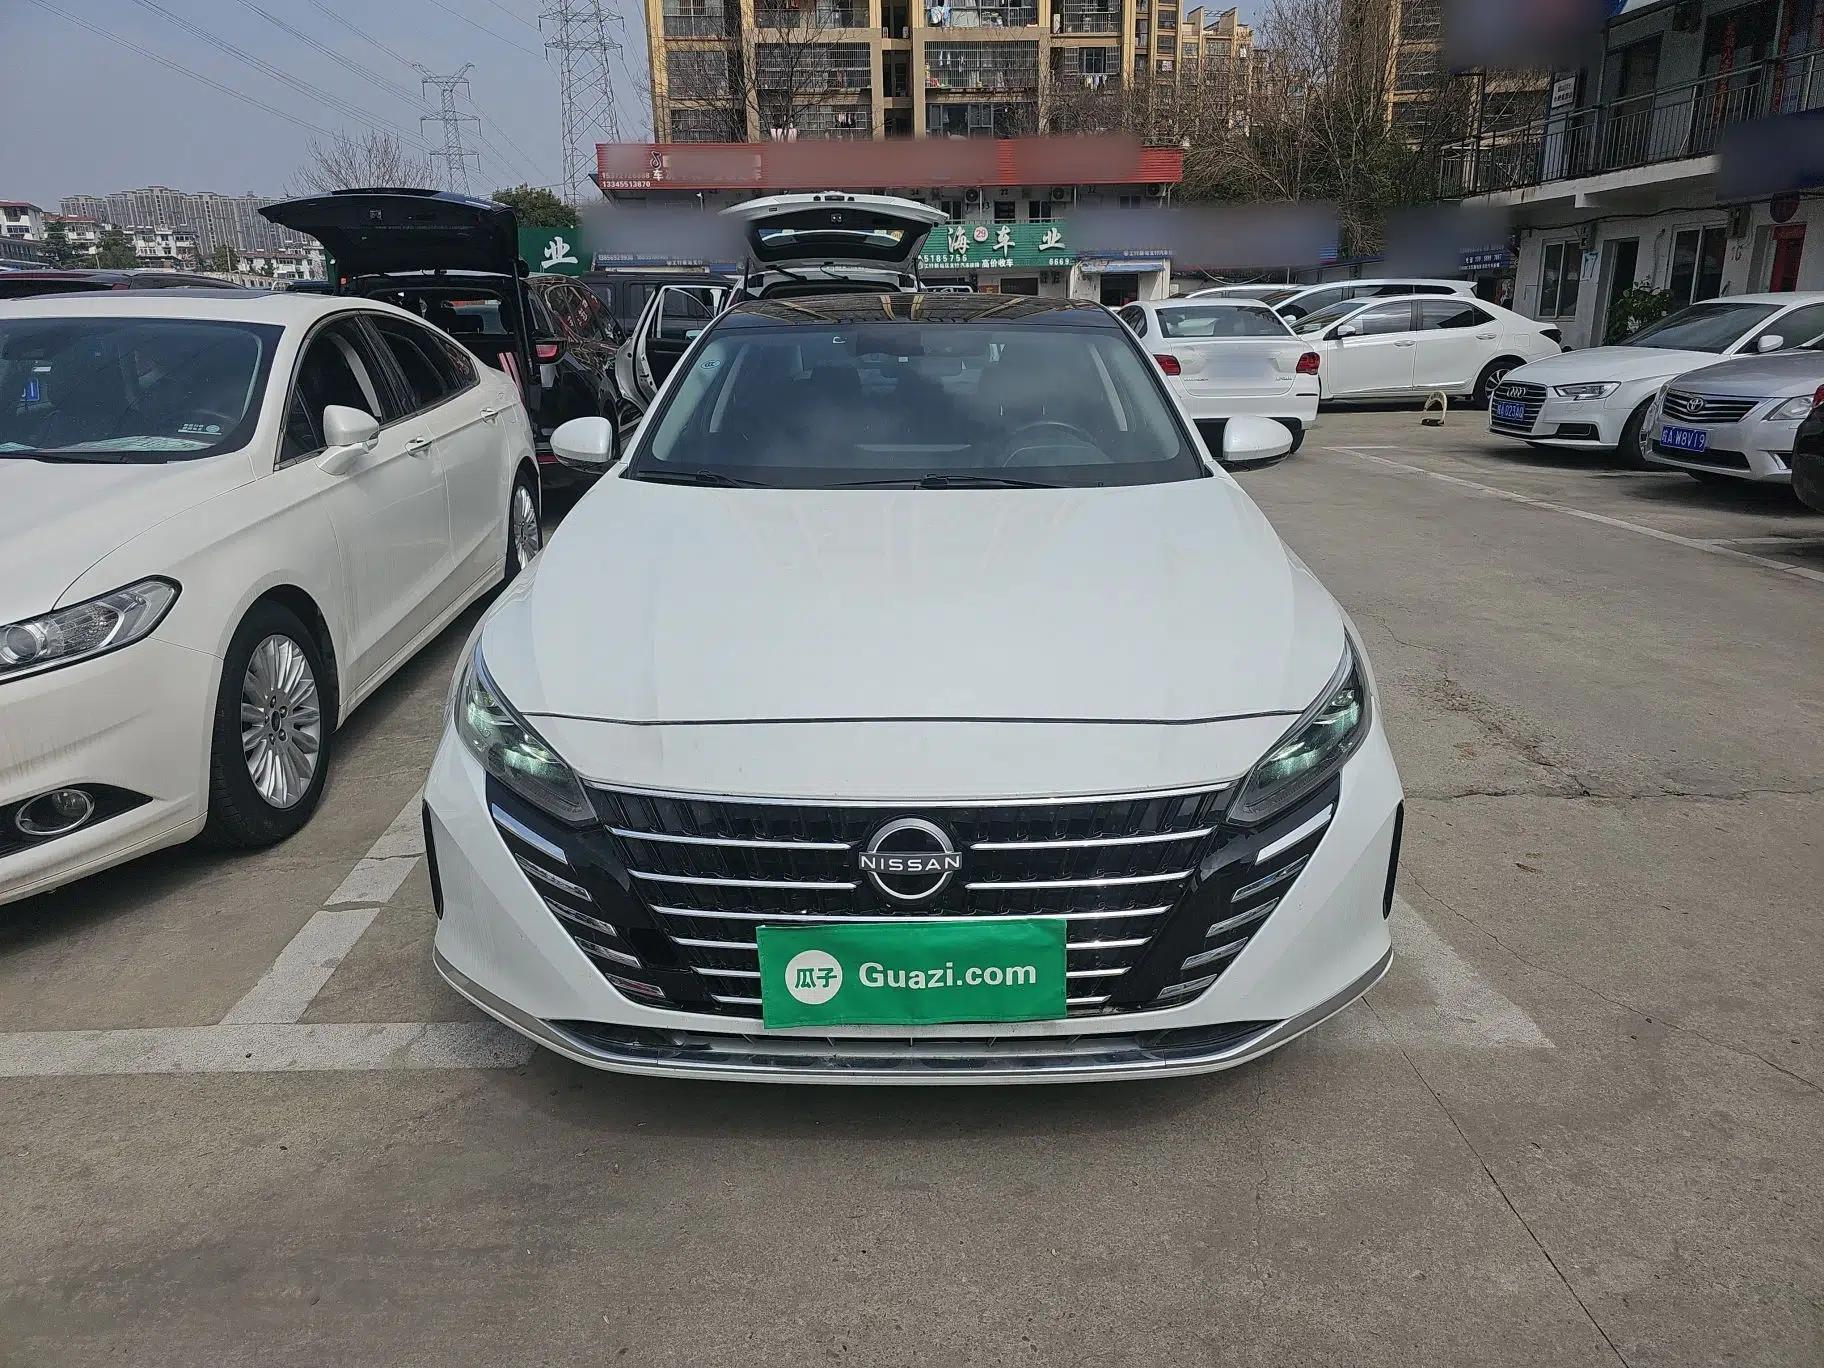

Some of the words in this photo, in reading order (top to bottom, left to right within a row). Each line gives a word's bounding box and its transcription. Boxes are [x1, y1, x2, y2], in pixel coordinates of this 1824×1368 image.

[975, 229, 986, 238] 29
[541, 236, 579, 269] 业
[981, 258, 1014, 268] 高价收车
[860, 855, 961, 871] NISSAN
[795, 968, 838, 989] 瓜子
[859, 962, 1037, 990] Guazi.com
